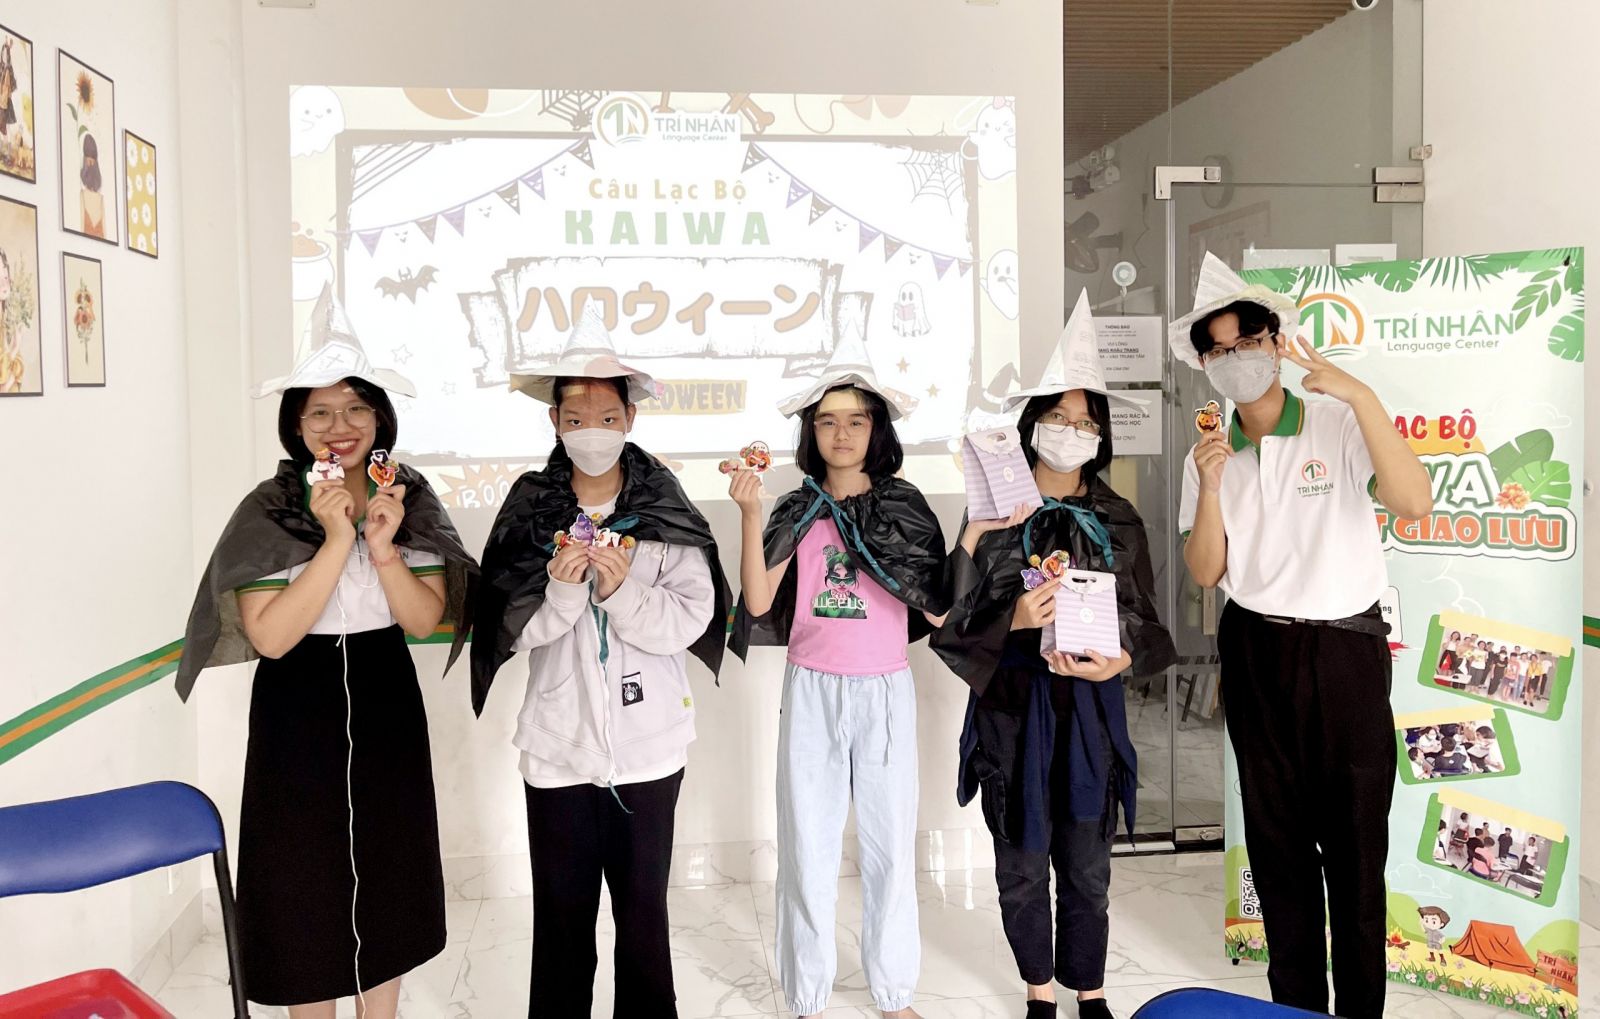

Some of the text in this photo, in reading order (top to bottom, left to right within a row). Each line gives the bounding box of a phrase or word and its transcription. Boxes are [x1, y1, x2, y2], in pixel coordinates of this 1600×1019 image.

[654, 114, 736, 133] TRÍ NHÂN
[588, 178, 747, 205] Câu Lạc Bộ
[565, 210, 771, 245] KAIWA
[516, 281, 821, 336] ハロウィーン
[1373, 310, 1514, 339] TRÍ NHÂN
[1387, 339, 1499, 353] Language Center
[1439, 408, 1477, 449] BỘ
[1393, 515, 1481, 544] GIAO
[1487, 515, 1562, 548] LƯU
